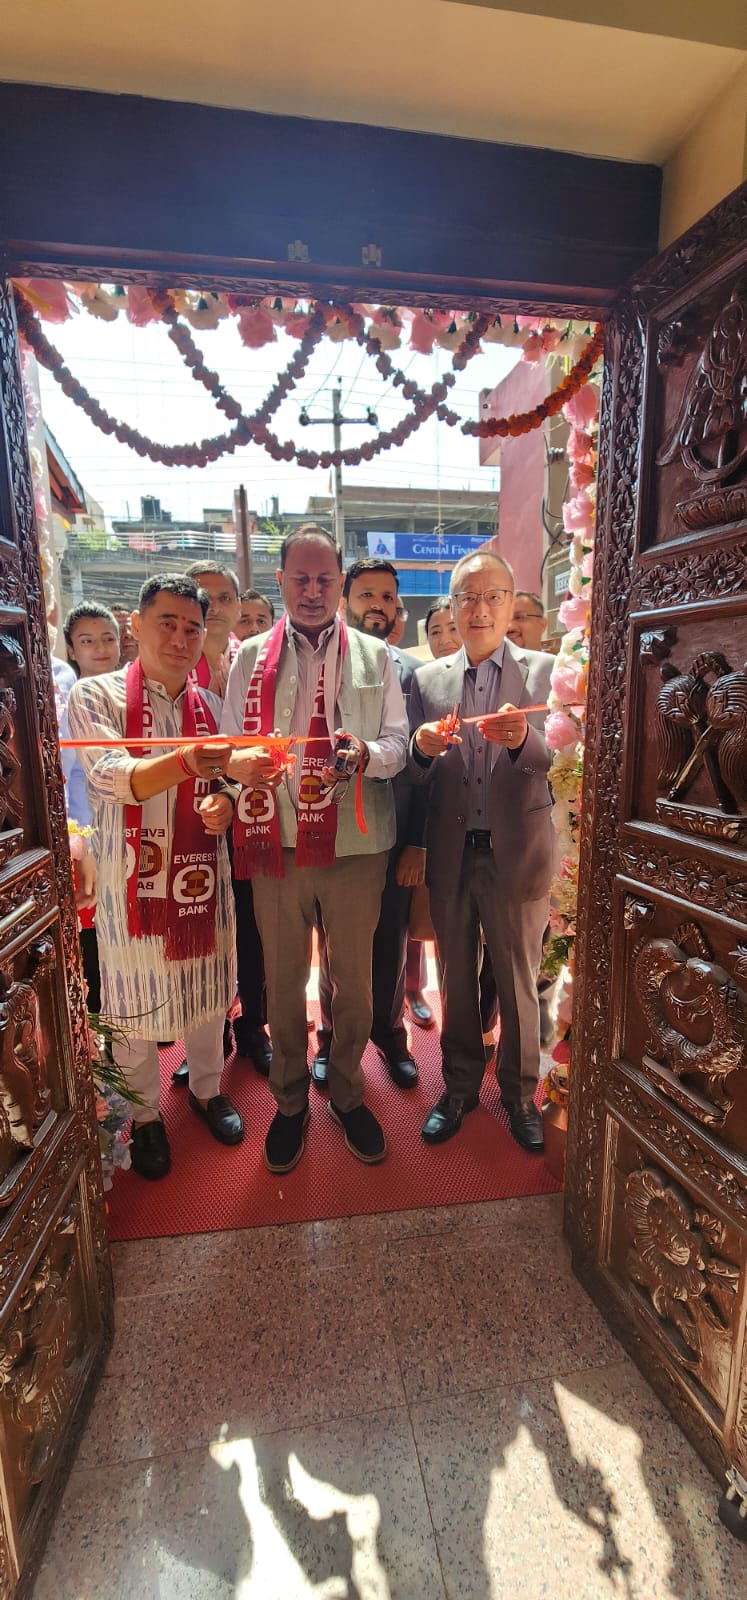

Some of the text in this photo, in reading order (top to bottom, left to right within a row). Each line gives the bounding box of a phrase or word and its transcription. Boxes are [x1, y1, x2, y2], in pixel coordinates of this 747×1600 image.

[245, 825, 271, 838] BANK
[173, 852, 216, 865] EVEREST
[178, 904, 209, 918] BANK
